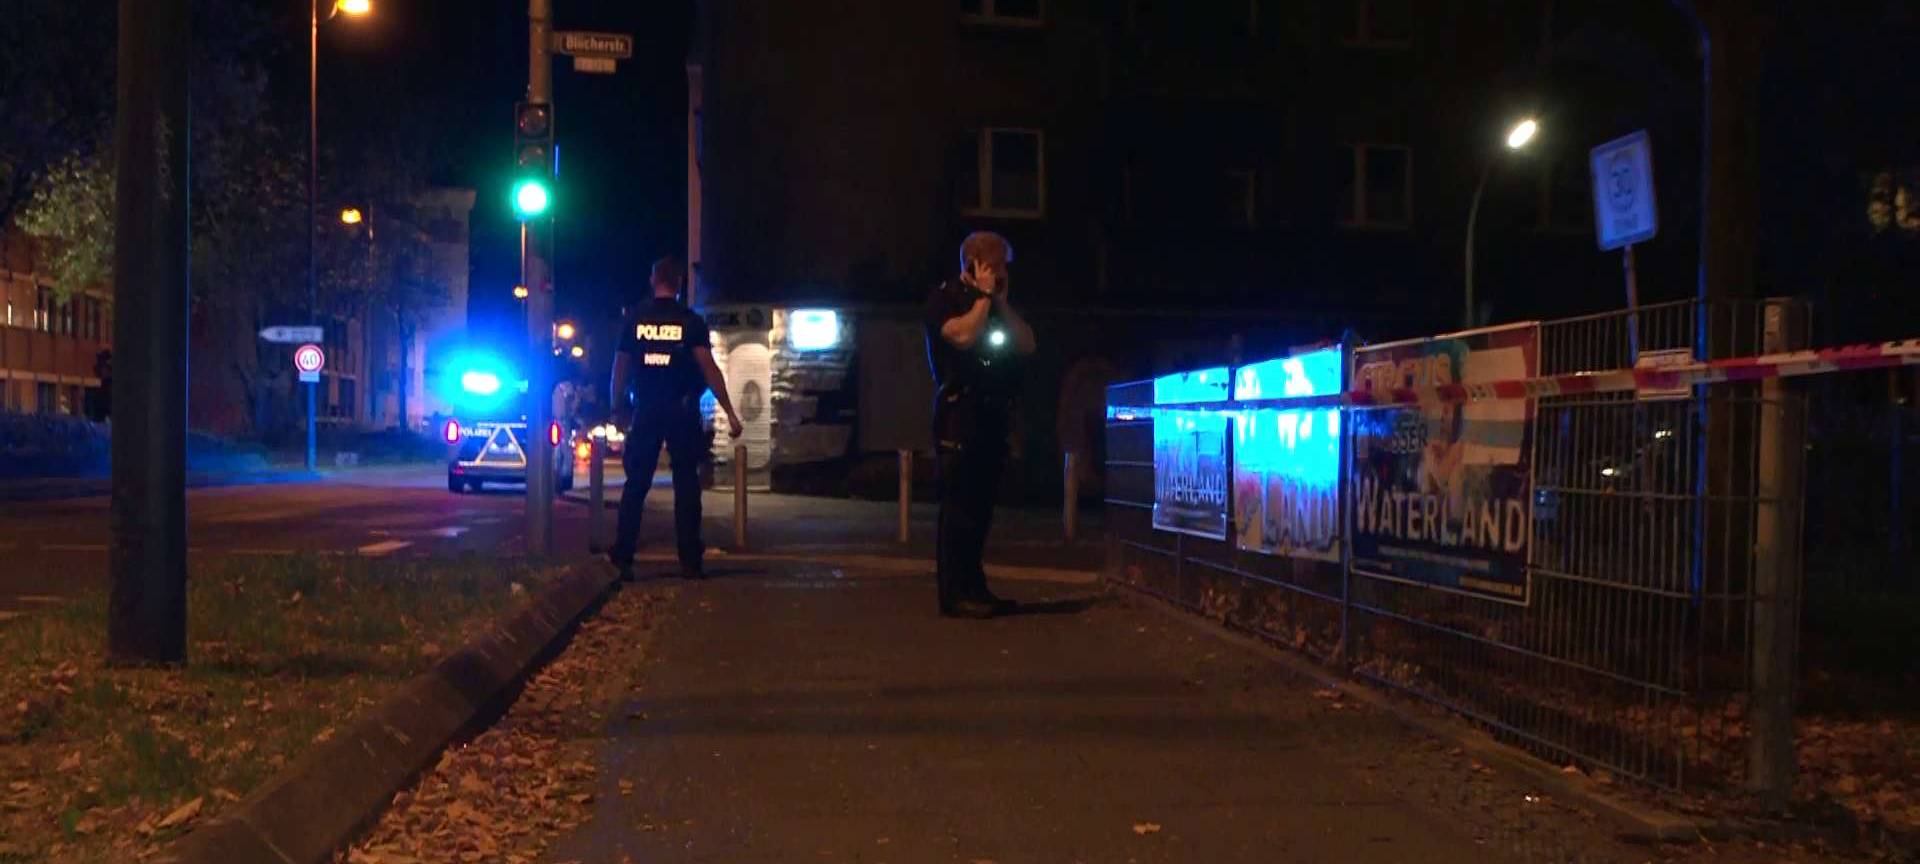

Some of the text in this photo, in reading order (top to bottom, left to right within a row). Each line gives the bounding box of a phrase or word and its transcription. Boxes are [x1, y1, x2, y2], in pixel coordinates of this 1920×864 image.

[636, 323, 683, 341] POLIZEI
[302, 353, 318, 366] 40
[643, 351, 672, 366] NRW
[1354, 474, 1527, 554] WATERLAND
